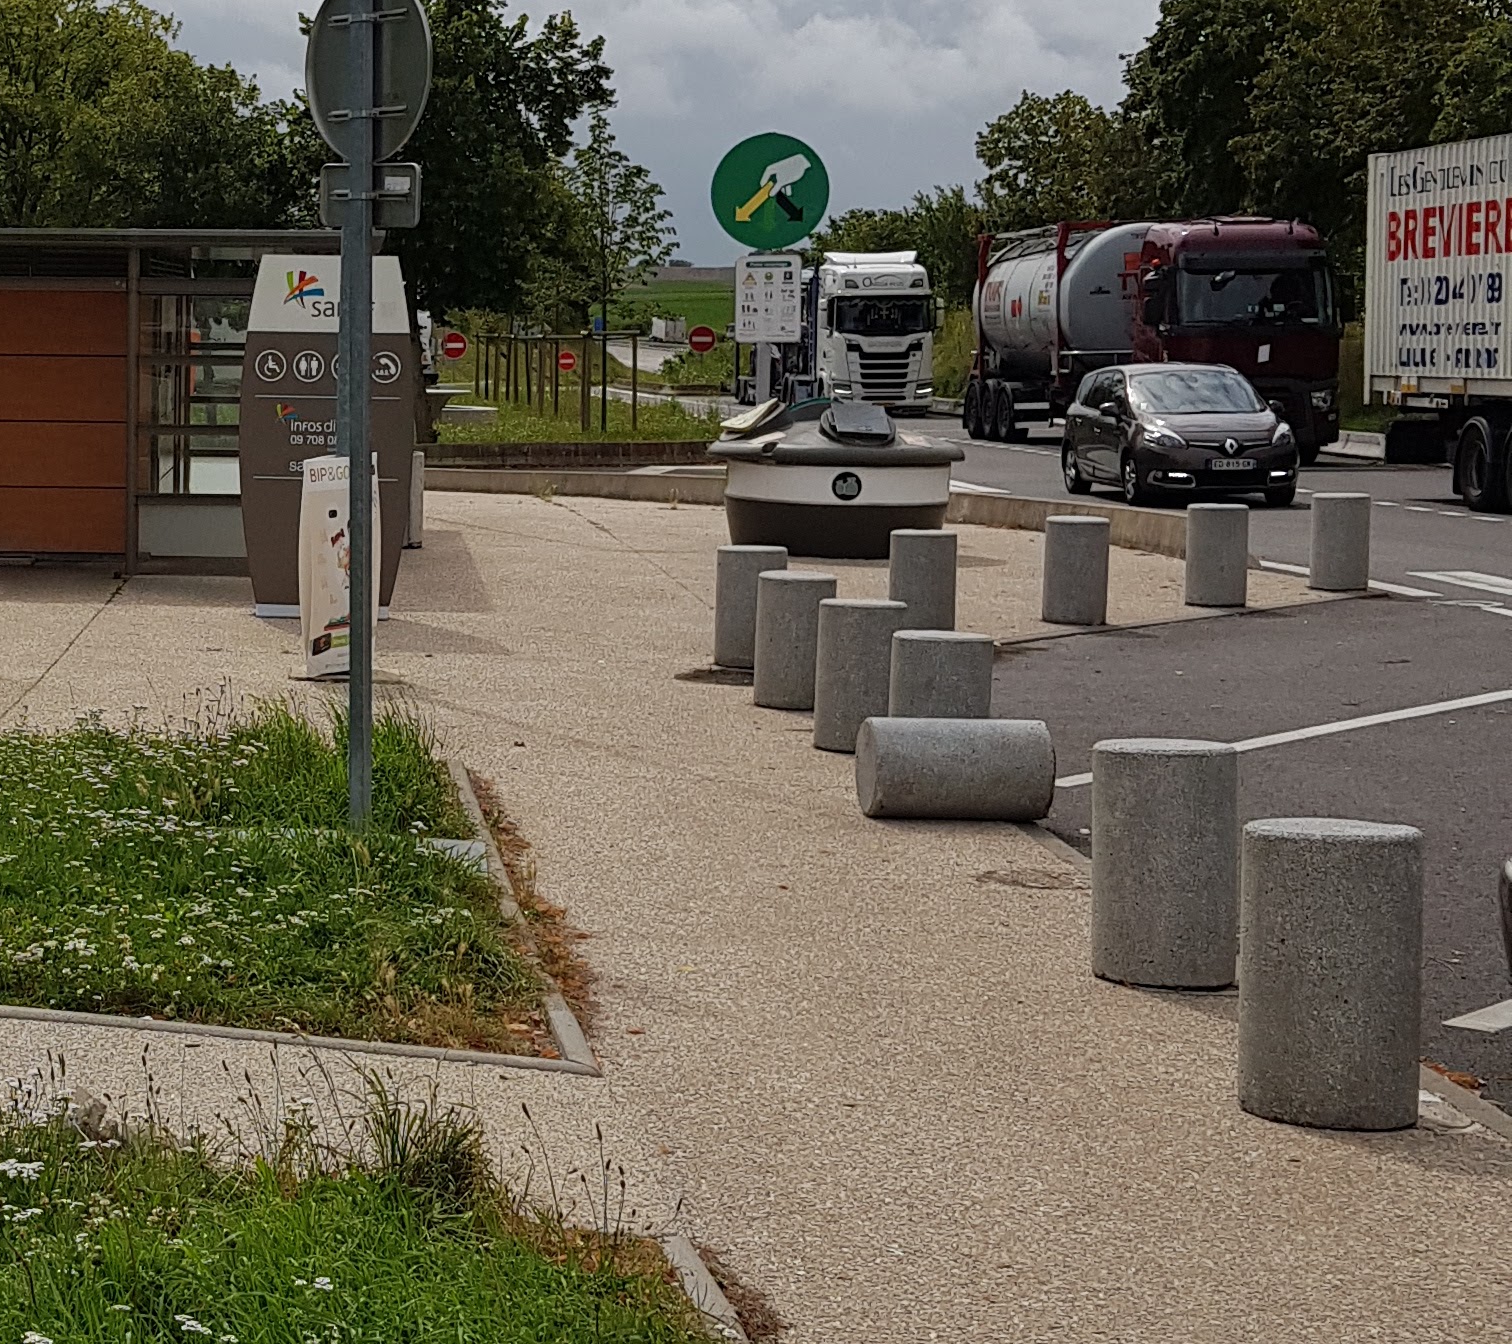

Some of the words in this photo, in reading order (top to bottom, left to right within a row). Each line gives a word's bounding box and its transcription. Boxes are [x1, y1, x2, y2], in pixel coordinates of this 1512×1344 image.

[324, 419, 336, 433] di
[290, 435, 304, 445] 09
[306, 435, 325, 445] 708
